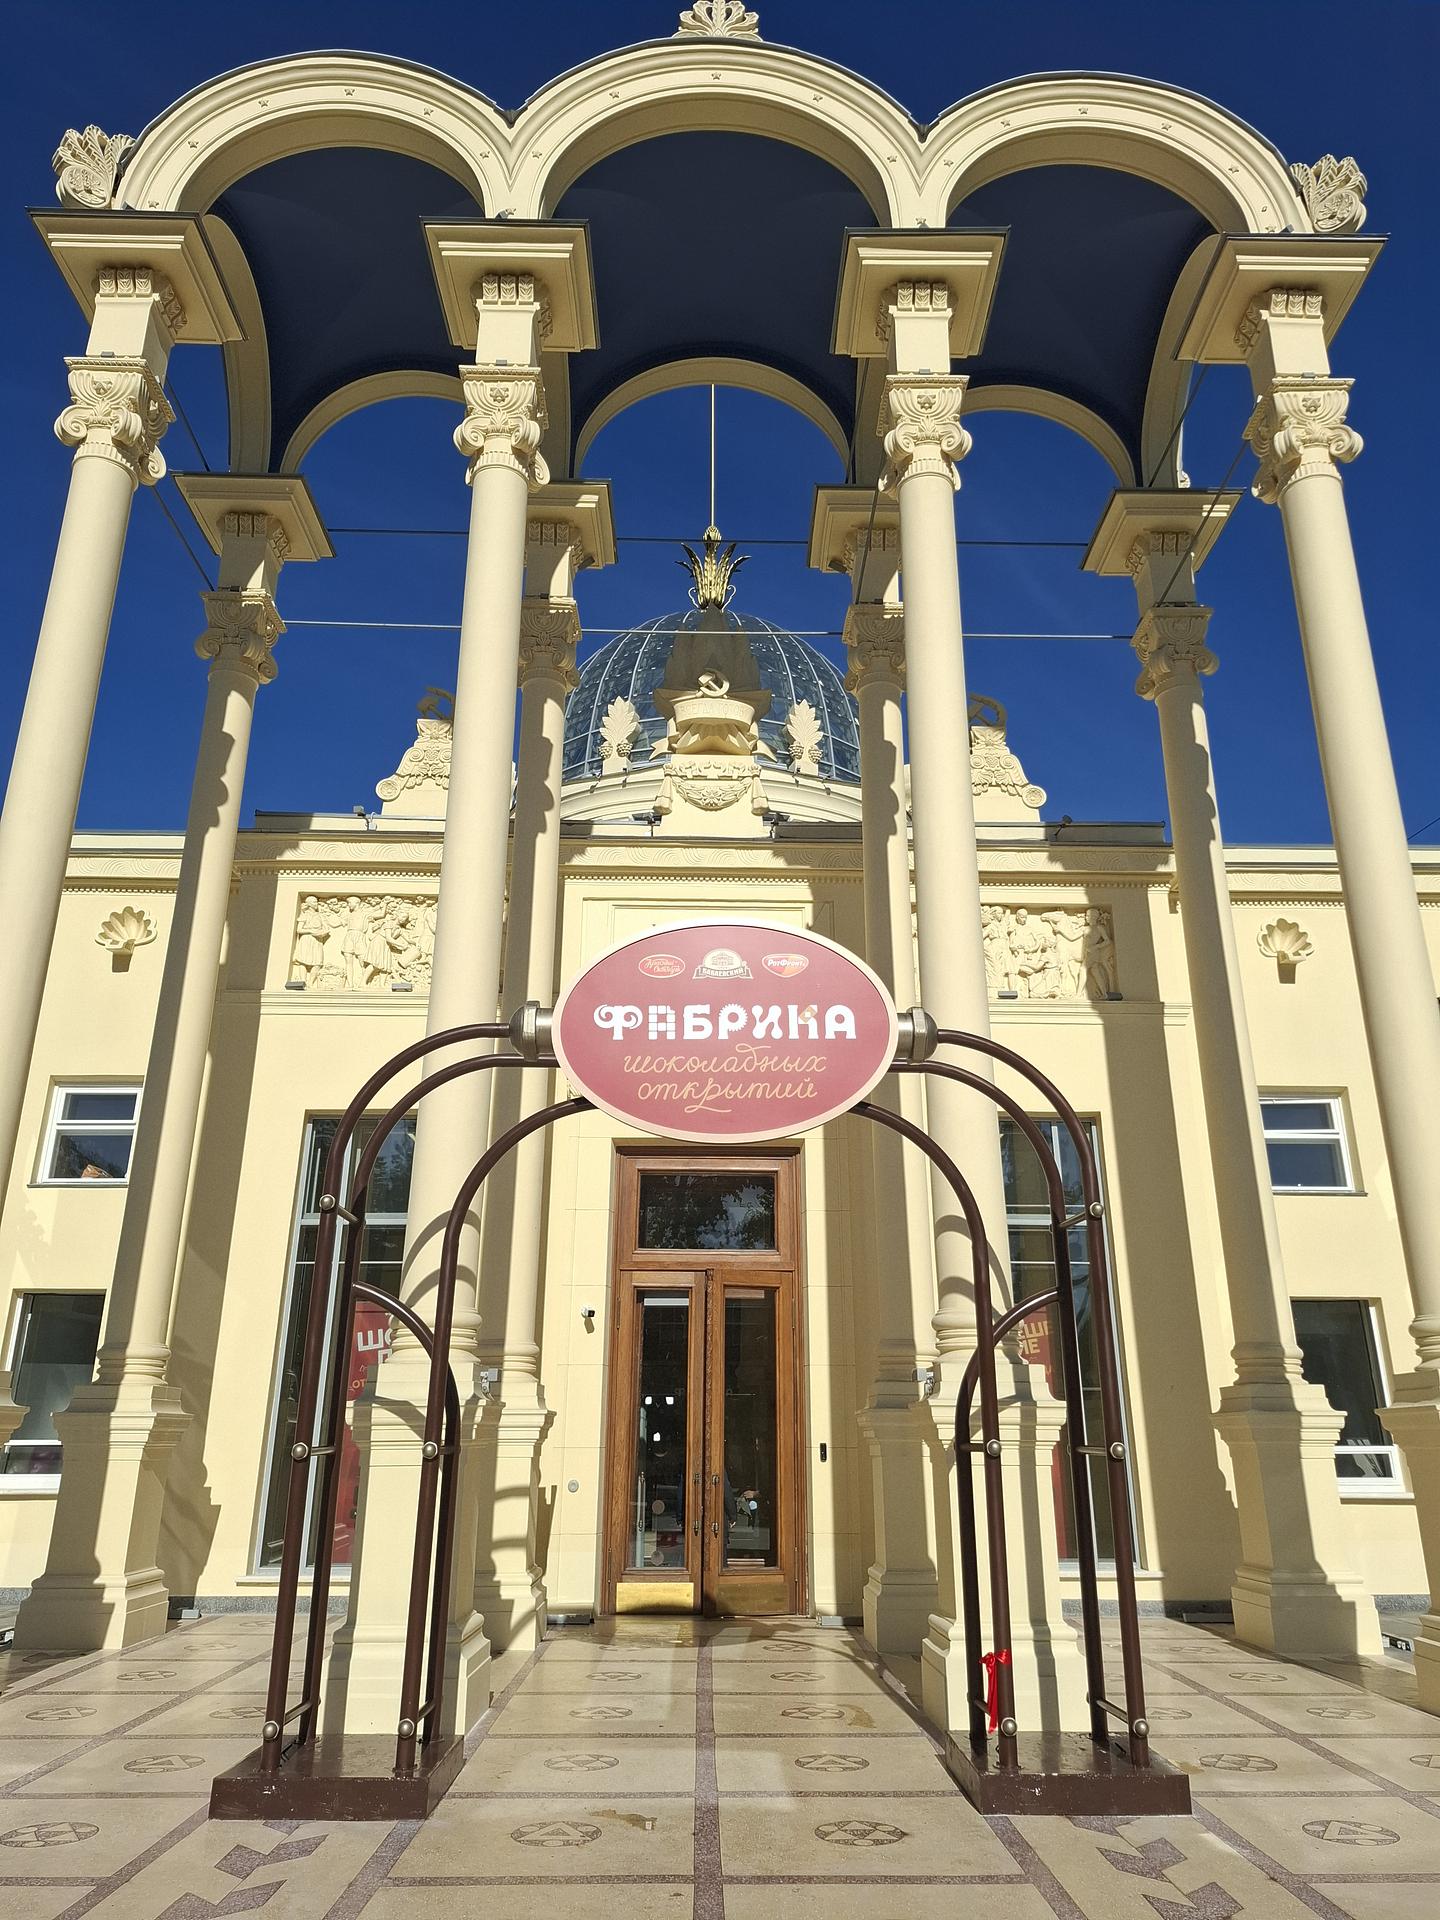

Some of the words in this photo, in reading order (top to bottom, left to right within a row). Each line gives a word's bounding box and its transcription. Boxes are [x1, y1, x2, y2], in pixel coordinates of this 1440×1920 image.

[593, 1003, 856, 1040] ФАБРИКА
[623, 1043, 826, 1073] шоколадных
[637, 1077, 818, 1113] открытий
